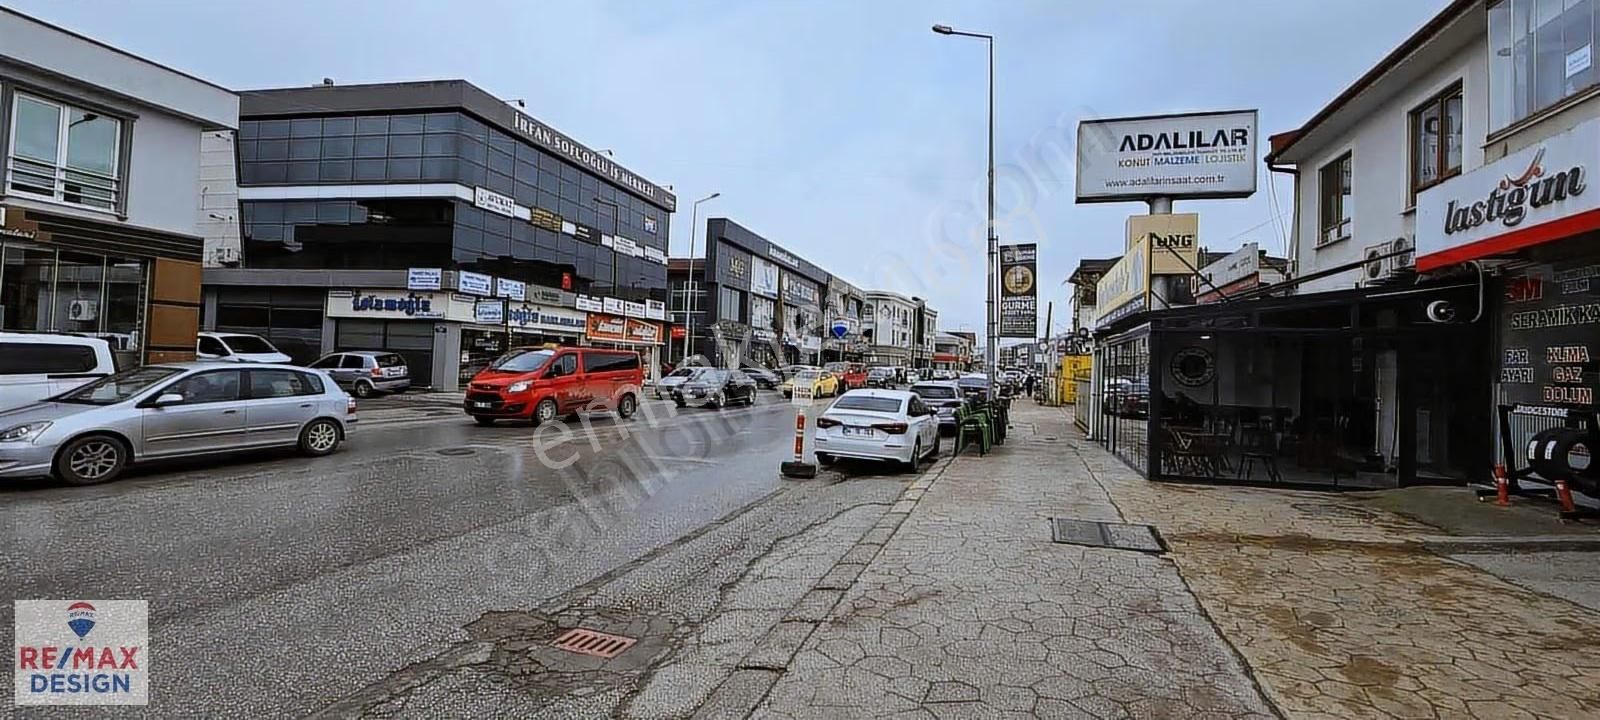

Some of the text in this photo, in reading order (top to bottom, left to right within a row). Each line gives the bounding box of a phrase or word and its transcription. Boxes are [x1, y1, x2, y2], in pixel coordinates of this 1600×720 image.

[514, 112, 552, 145] İRFAN
[1119, 128, 1249, 152] ADALILAR
[1118, 157, 1151, 168] KONUT
[1153, 155, 1201, 166] MALZEME
[1511, 305, 1577, 330] SERAMİK
[1504, 349, 1529, 364] FAR
[1500, 367, 1534, 383] AYARI
[1553, 367, 1583, 383] GAZ
[1543, 386, 1593, 404] DOLUM
